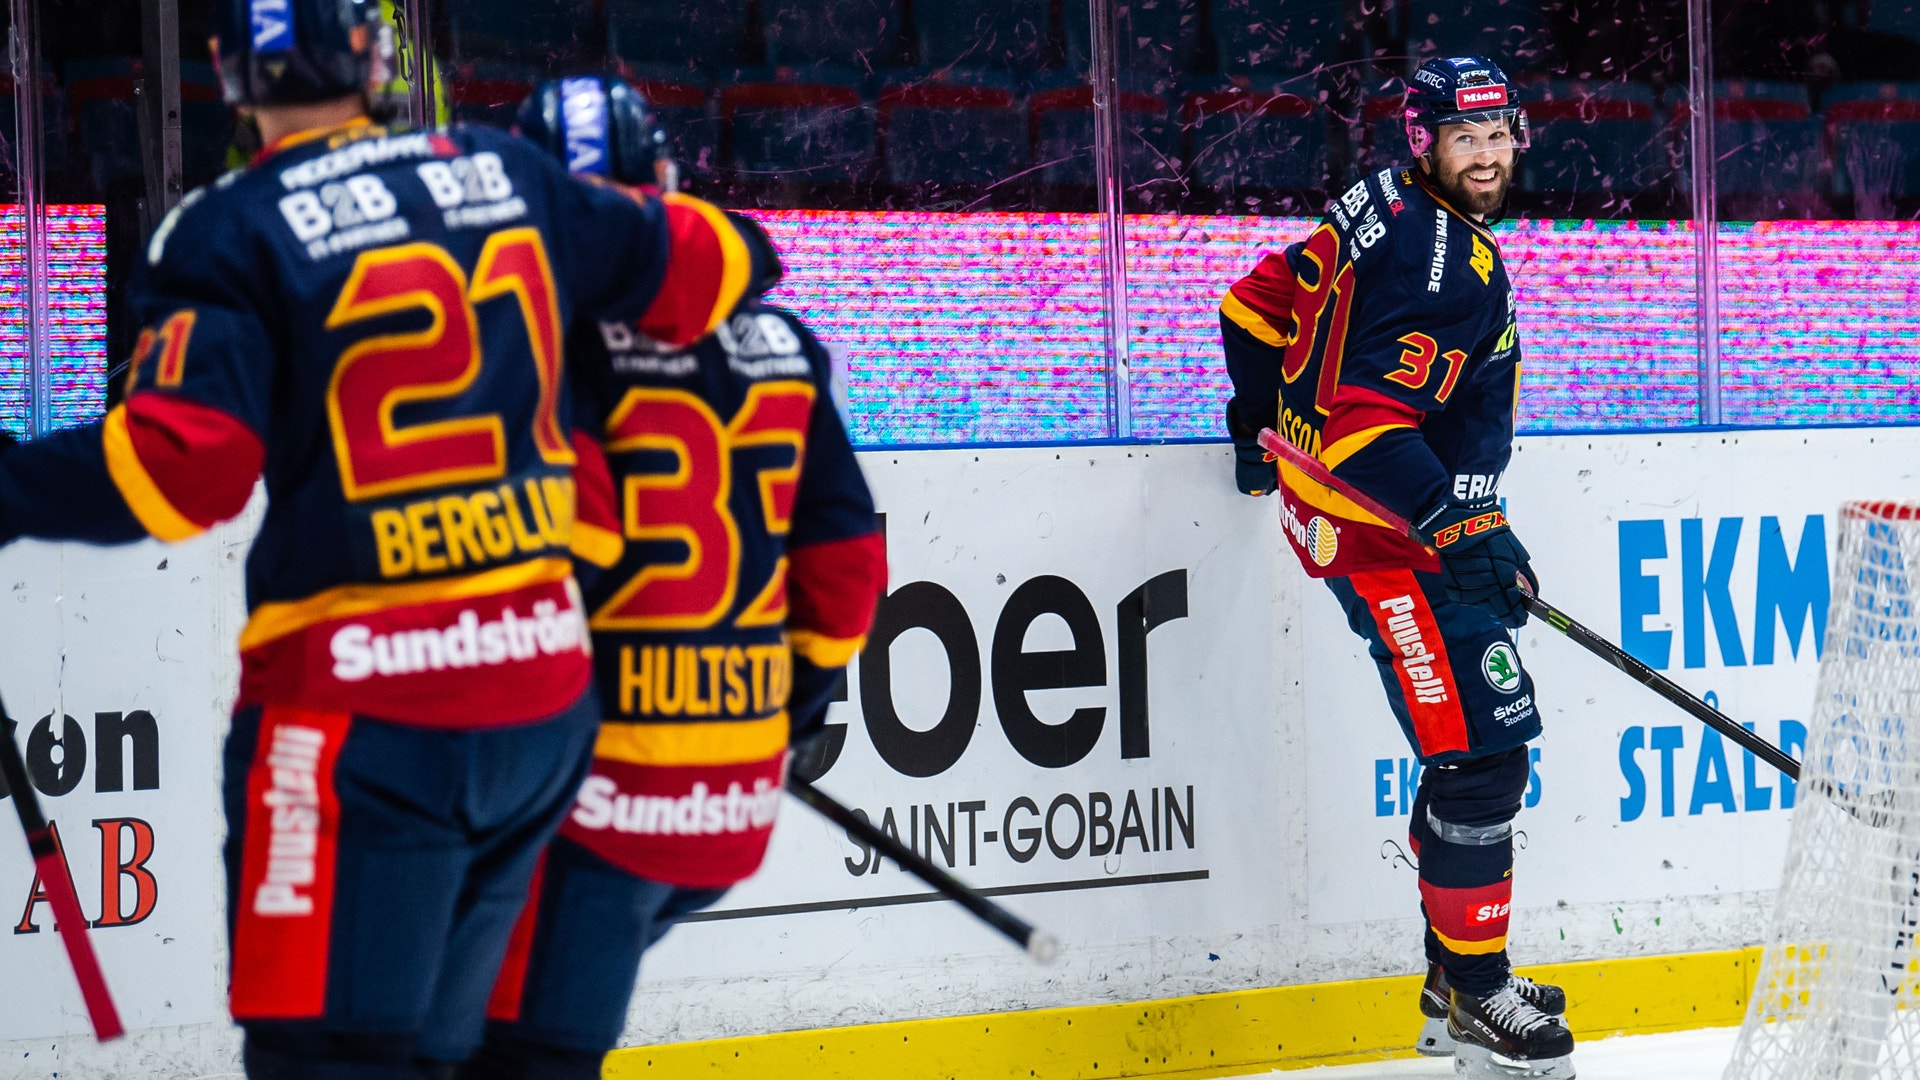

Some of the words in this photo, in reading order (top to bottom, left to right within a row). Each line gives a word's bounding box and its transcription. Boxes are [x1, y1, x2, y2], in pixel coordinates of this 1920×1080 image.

[1463, 92, 1502, 103] Miele
[279, 174, 397, 243] B2B
[417, 152, 512, 208] B2B
[325, 227, 577, 502] 21
[1384, 332, 1467, 403] 31
[1433, 511, 1510, 548] CCM
[1379, 594, 1448, 703] Puustelli
[0, 709, 160, 799] on
[254, 724, 325, 916] Puustelli
[844, 785, 1195, 877] SAINT-GOBAIN
[14, 816, 158, 935] AB
[1476, 903, 1510, 922] Sta
[1473, 1018, 1500, 1043] CCM
